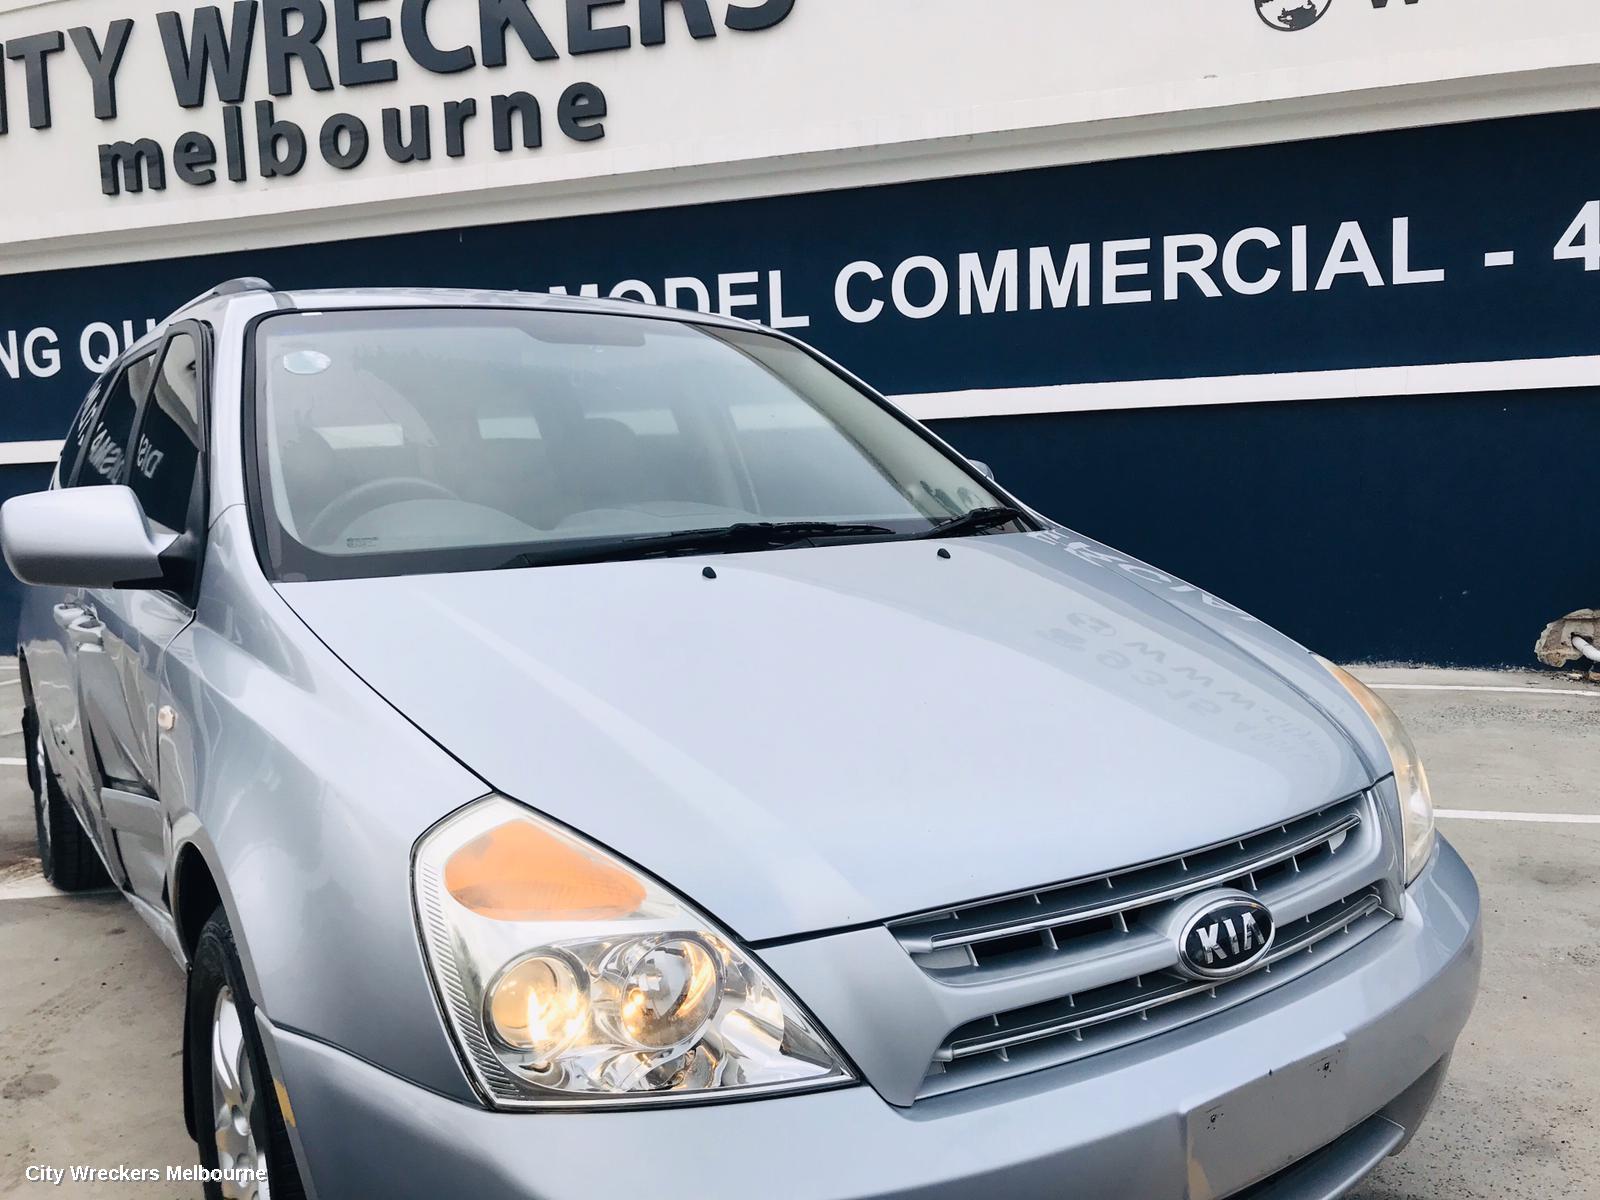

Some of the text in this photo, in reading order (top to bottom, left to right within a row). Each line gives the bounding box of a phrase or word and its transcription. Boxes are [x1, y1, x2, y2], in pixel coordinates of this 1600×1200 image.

[98, 80, 608, 196] melbourne
[549, 269, 811, 329] DEL
[833, 216, 1445, 324] COMMERCIAL
[1196, 911, 1265, 964] KIA
